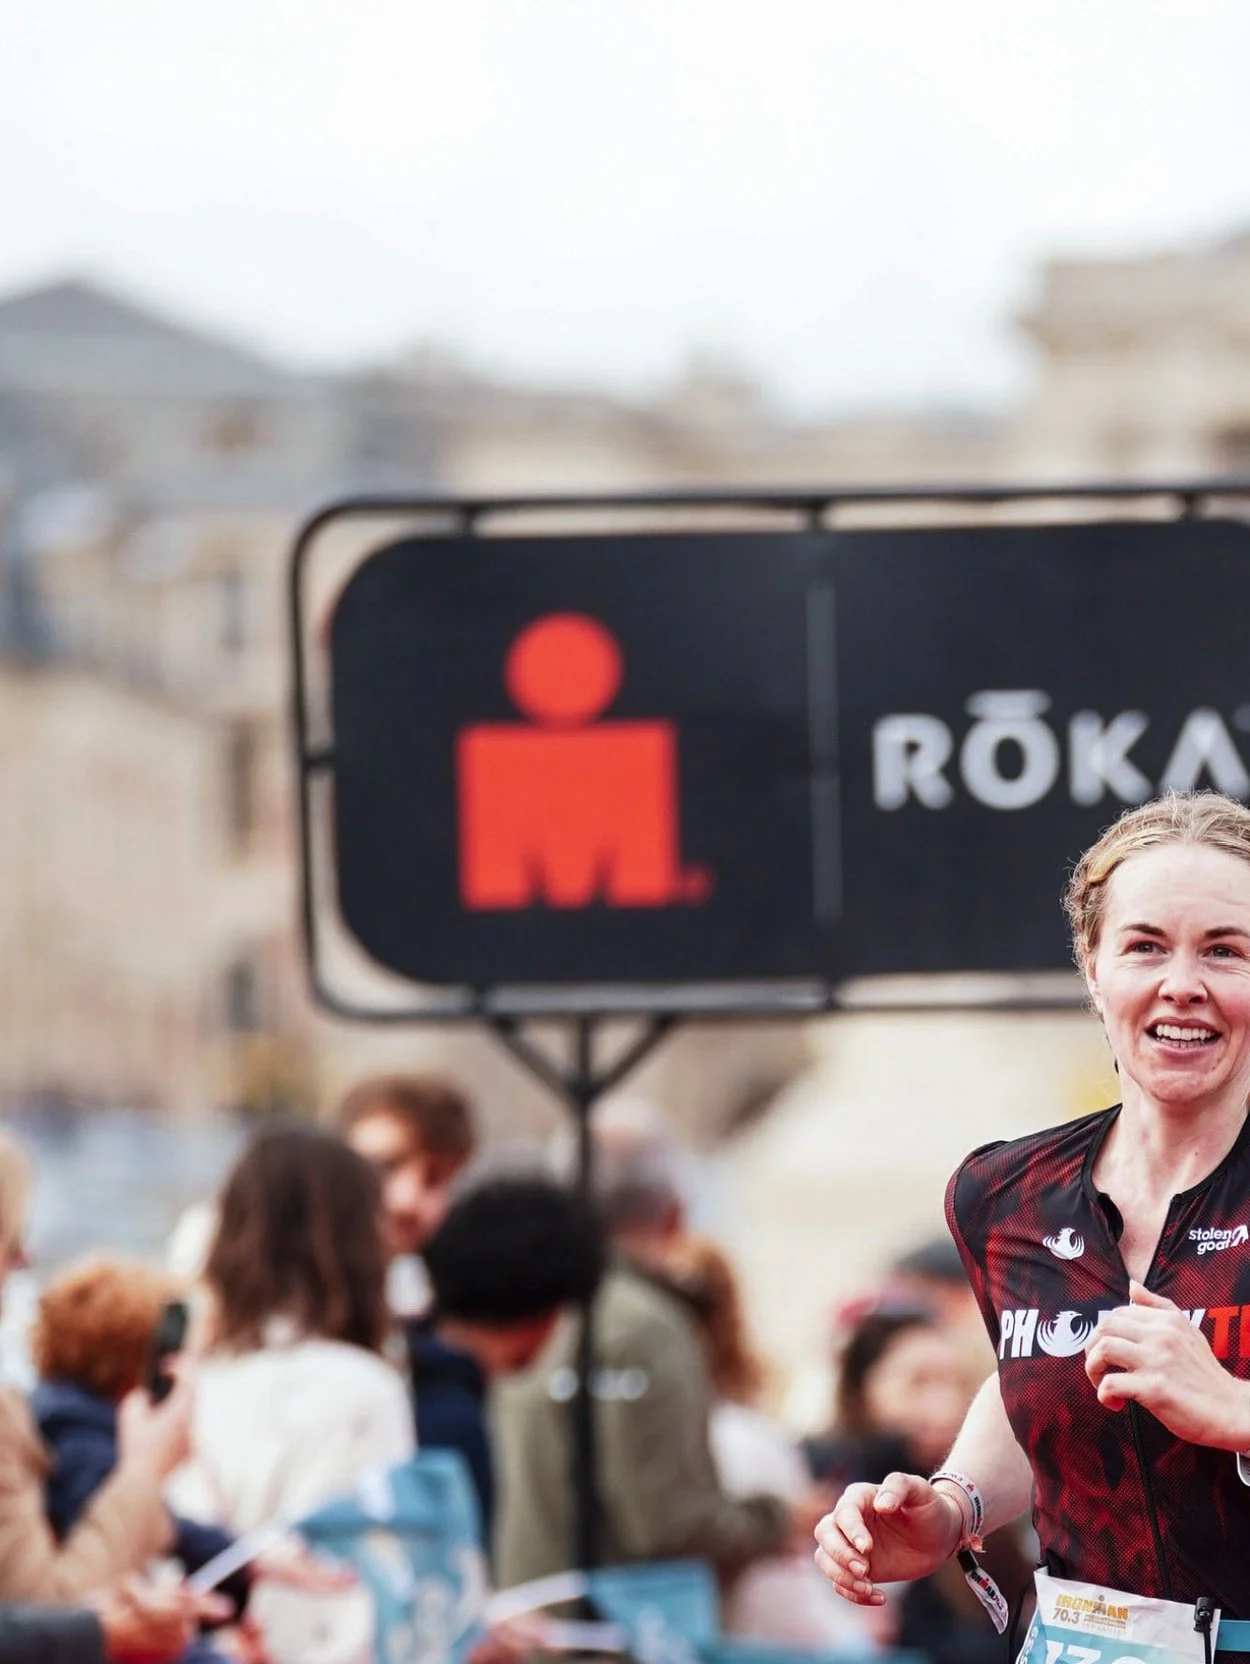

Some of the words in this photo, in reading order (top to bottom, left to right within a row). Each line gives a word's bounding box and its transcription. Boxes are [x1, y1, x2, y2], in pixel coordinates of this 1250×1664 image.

[1189, 1227, 1231, 1240] stolen
[1197, 1239, 1232, 1255] goat
[1052, 1607, 1080, 1624] 70.3
[1055, 1594, 1128, 1621] IRONMAN
